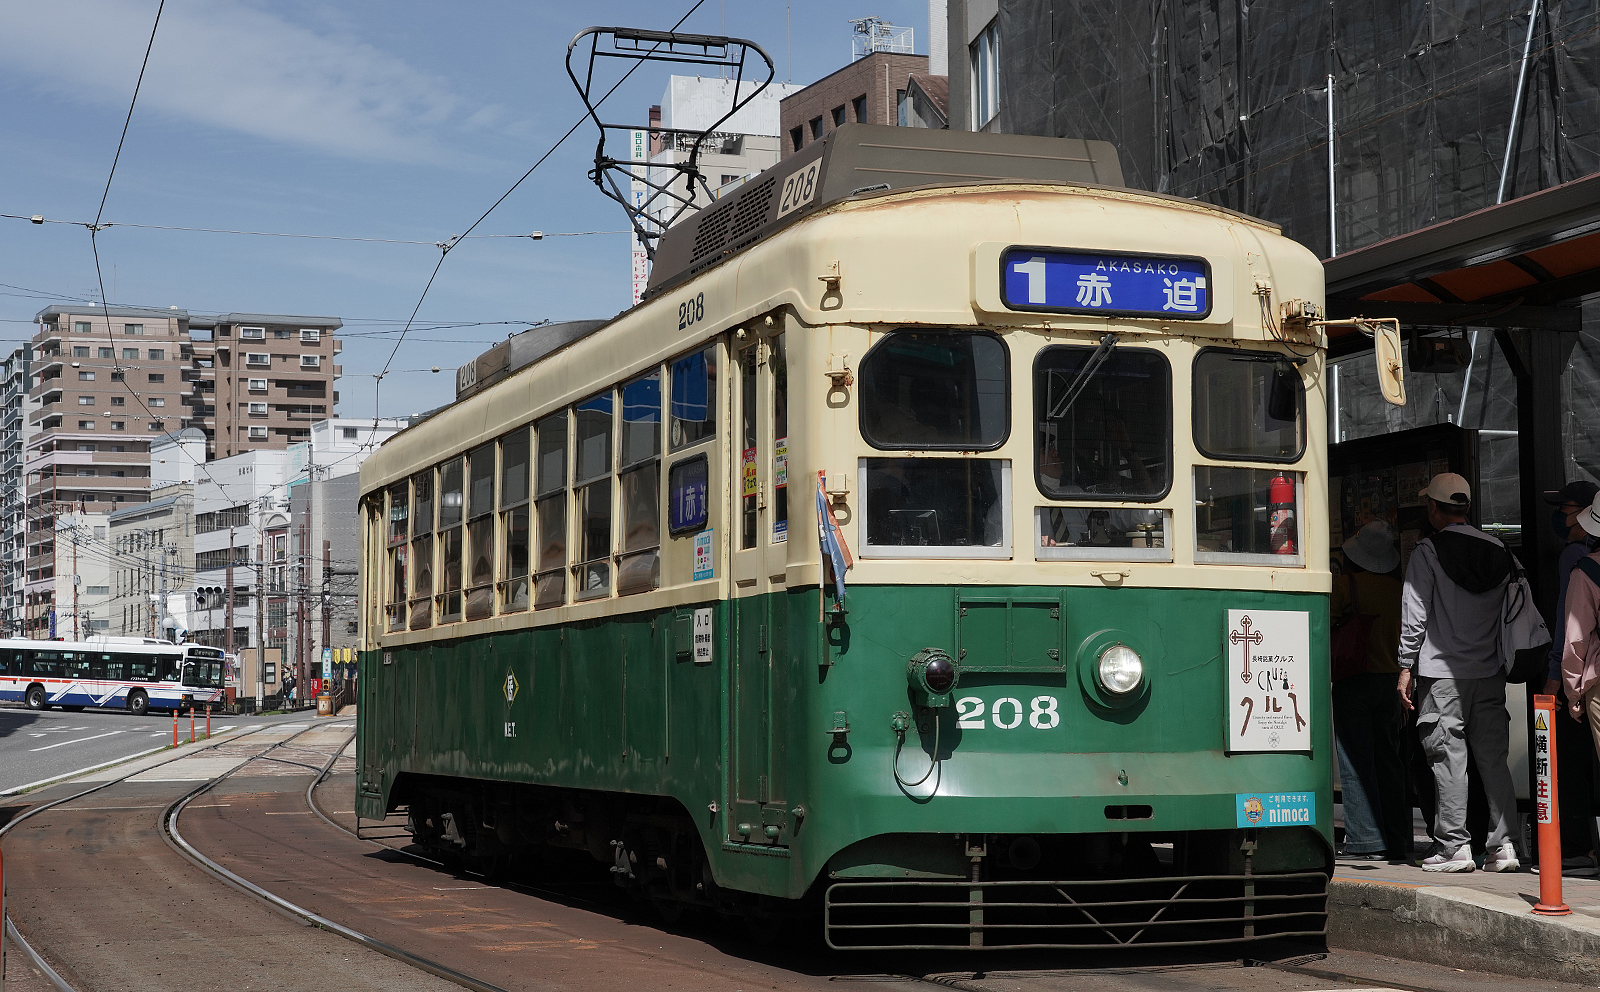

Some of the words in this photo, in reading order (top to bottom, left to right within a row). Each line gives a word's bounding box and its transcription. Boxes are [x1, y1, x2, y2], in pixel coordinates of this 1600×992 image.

[635, 132, 643, 158] 田口歯科
[781, 165, 816, 213] 208
[1014, 256, 1046, 304] 1
[1096, 260, 1179, 276] AKASAKO
[678, 292, 704, 331] 208
[1076, 272, 1198, 312] 赤迫
[461, 359, 475, 388] 208
[678, 469, 684, 524] 1
[696, 614, 709, 628] 入口
[955, 695, 1060, 730] 208
[1240, 692, 1307, 737] クルス
[1535, 734, 1549, 821] 横断注意
[1269, 804, 1310, 823] nimoca
